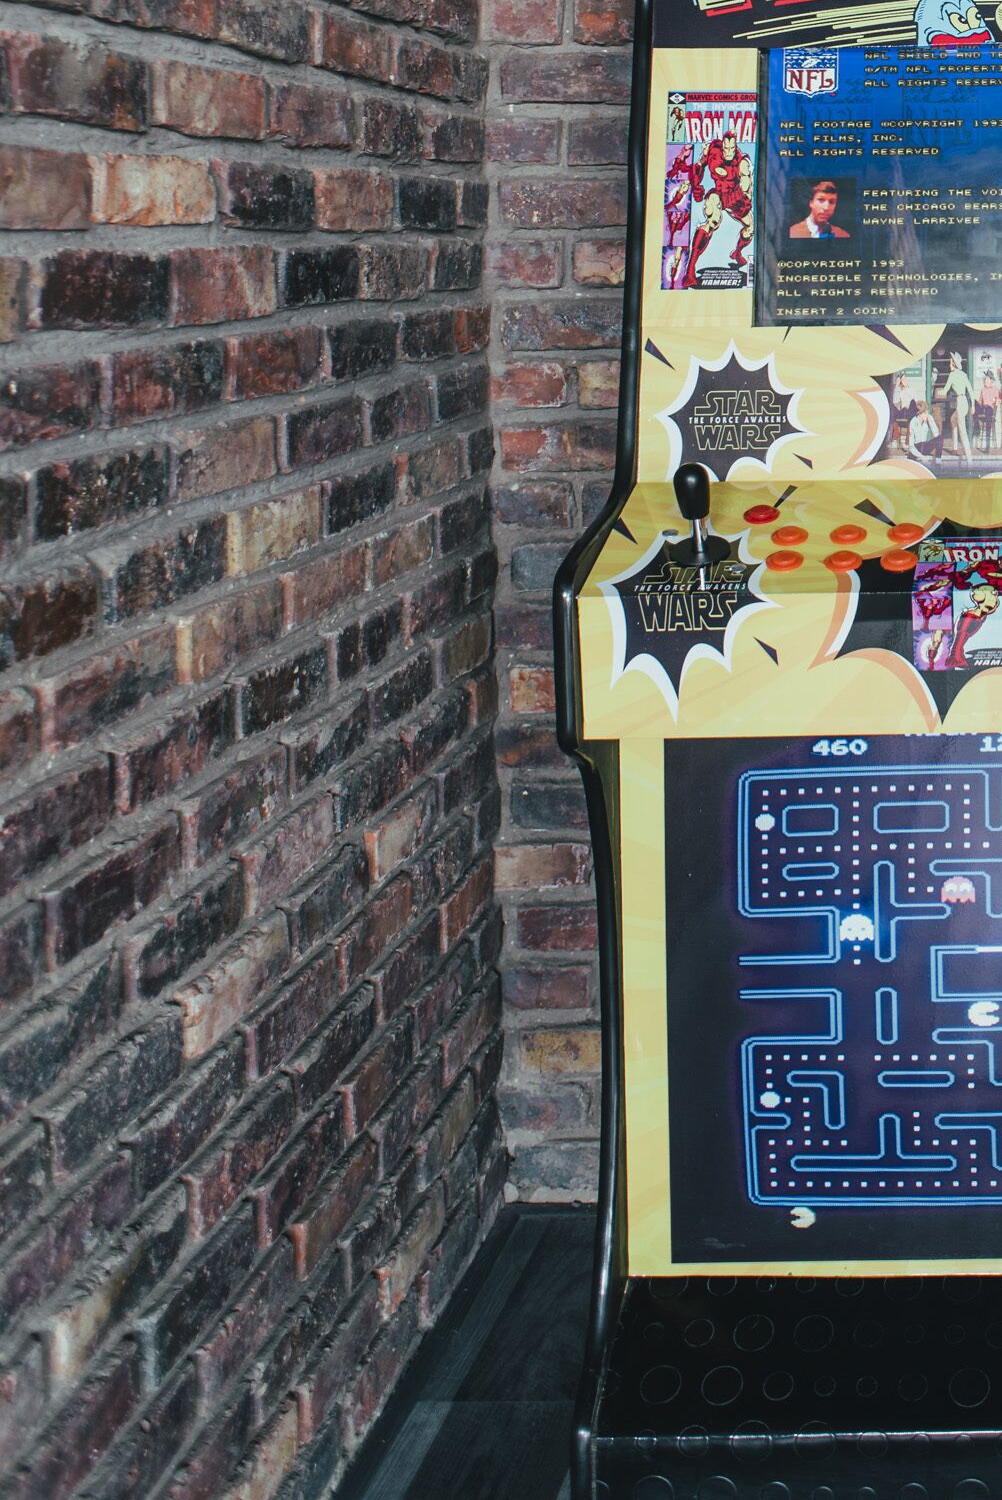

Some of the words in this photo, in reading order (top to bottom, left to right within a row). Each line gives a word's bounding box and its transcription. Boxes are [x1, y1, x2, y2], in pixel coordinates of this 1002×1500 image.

[864, 52, 889, 60] NFL
[898, 52, 947, 60] SHIELD
[786, 69, 834, 91] NFL
[688, 93, 712, 101] MARVEL
[714, 93, 738, 101] COMICS
[684, 111, 724, 143] IRON
[780, 121, 804, 129] NFL
[813, 121, 872, 129] FOOTAGE
[780, 135, 804, 143] NFL
[813, 135, 862, 143] FILMS,
[872, 134, 903, 142] INC.
[780, 149, 804, 157] ALL
[872, 148, 939, 156] RESERVED
[863, 189, 939, 197] FEATURING
[863, 203, 888, 211] THE
[896, 203, 956, 211] CHICAGO
[863, 217, 904, 225] WAYNE
[913, 217, 981, 225] LARRIVEE
[871, 259, 905, 267] 1993
[777, 274, 862, 282] INCREDIBLE
[871, 273, 979, 283] TECHNOLOGIES,
[701, 279, 742, 287] HAMMER!
[776, 289, 802, 297] ALL
[810, 288, 862, 296] RIGHTS
[870, 288, 938, 296] RESERVED
[776, 308, 827, 316] INSERT
[836, 308, 844, 316] 2
[853, 307, 896, 316] COINS
[694, 390, 781, 416] STAR
[744, 415, 787, 423] AWAKENS
[694, 424, 781, 451] WARS
[943, 546, 999, 563] IRON
[657, 584, 692, 592] FORCE
[638, 591, 738, 632] WARS
[812, 739, 868, 756] 460
